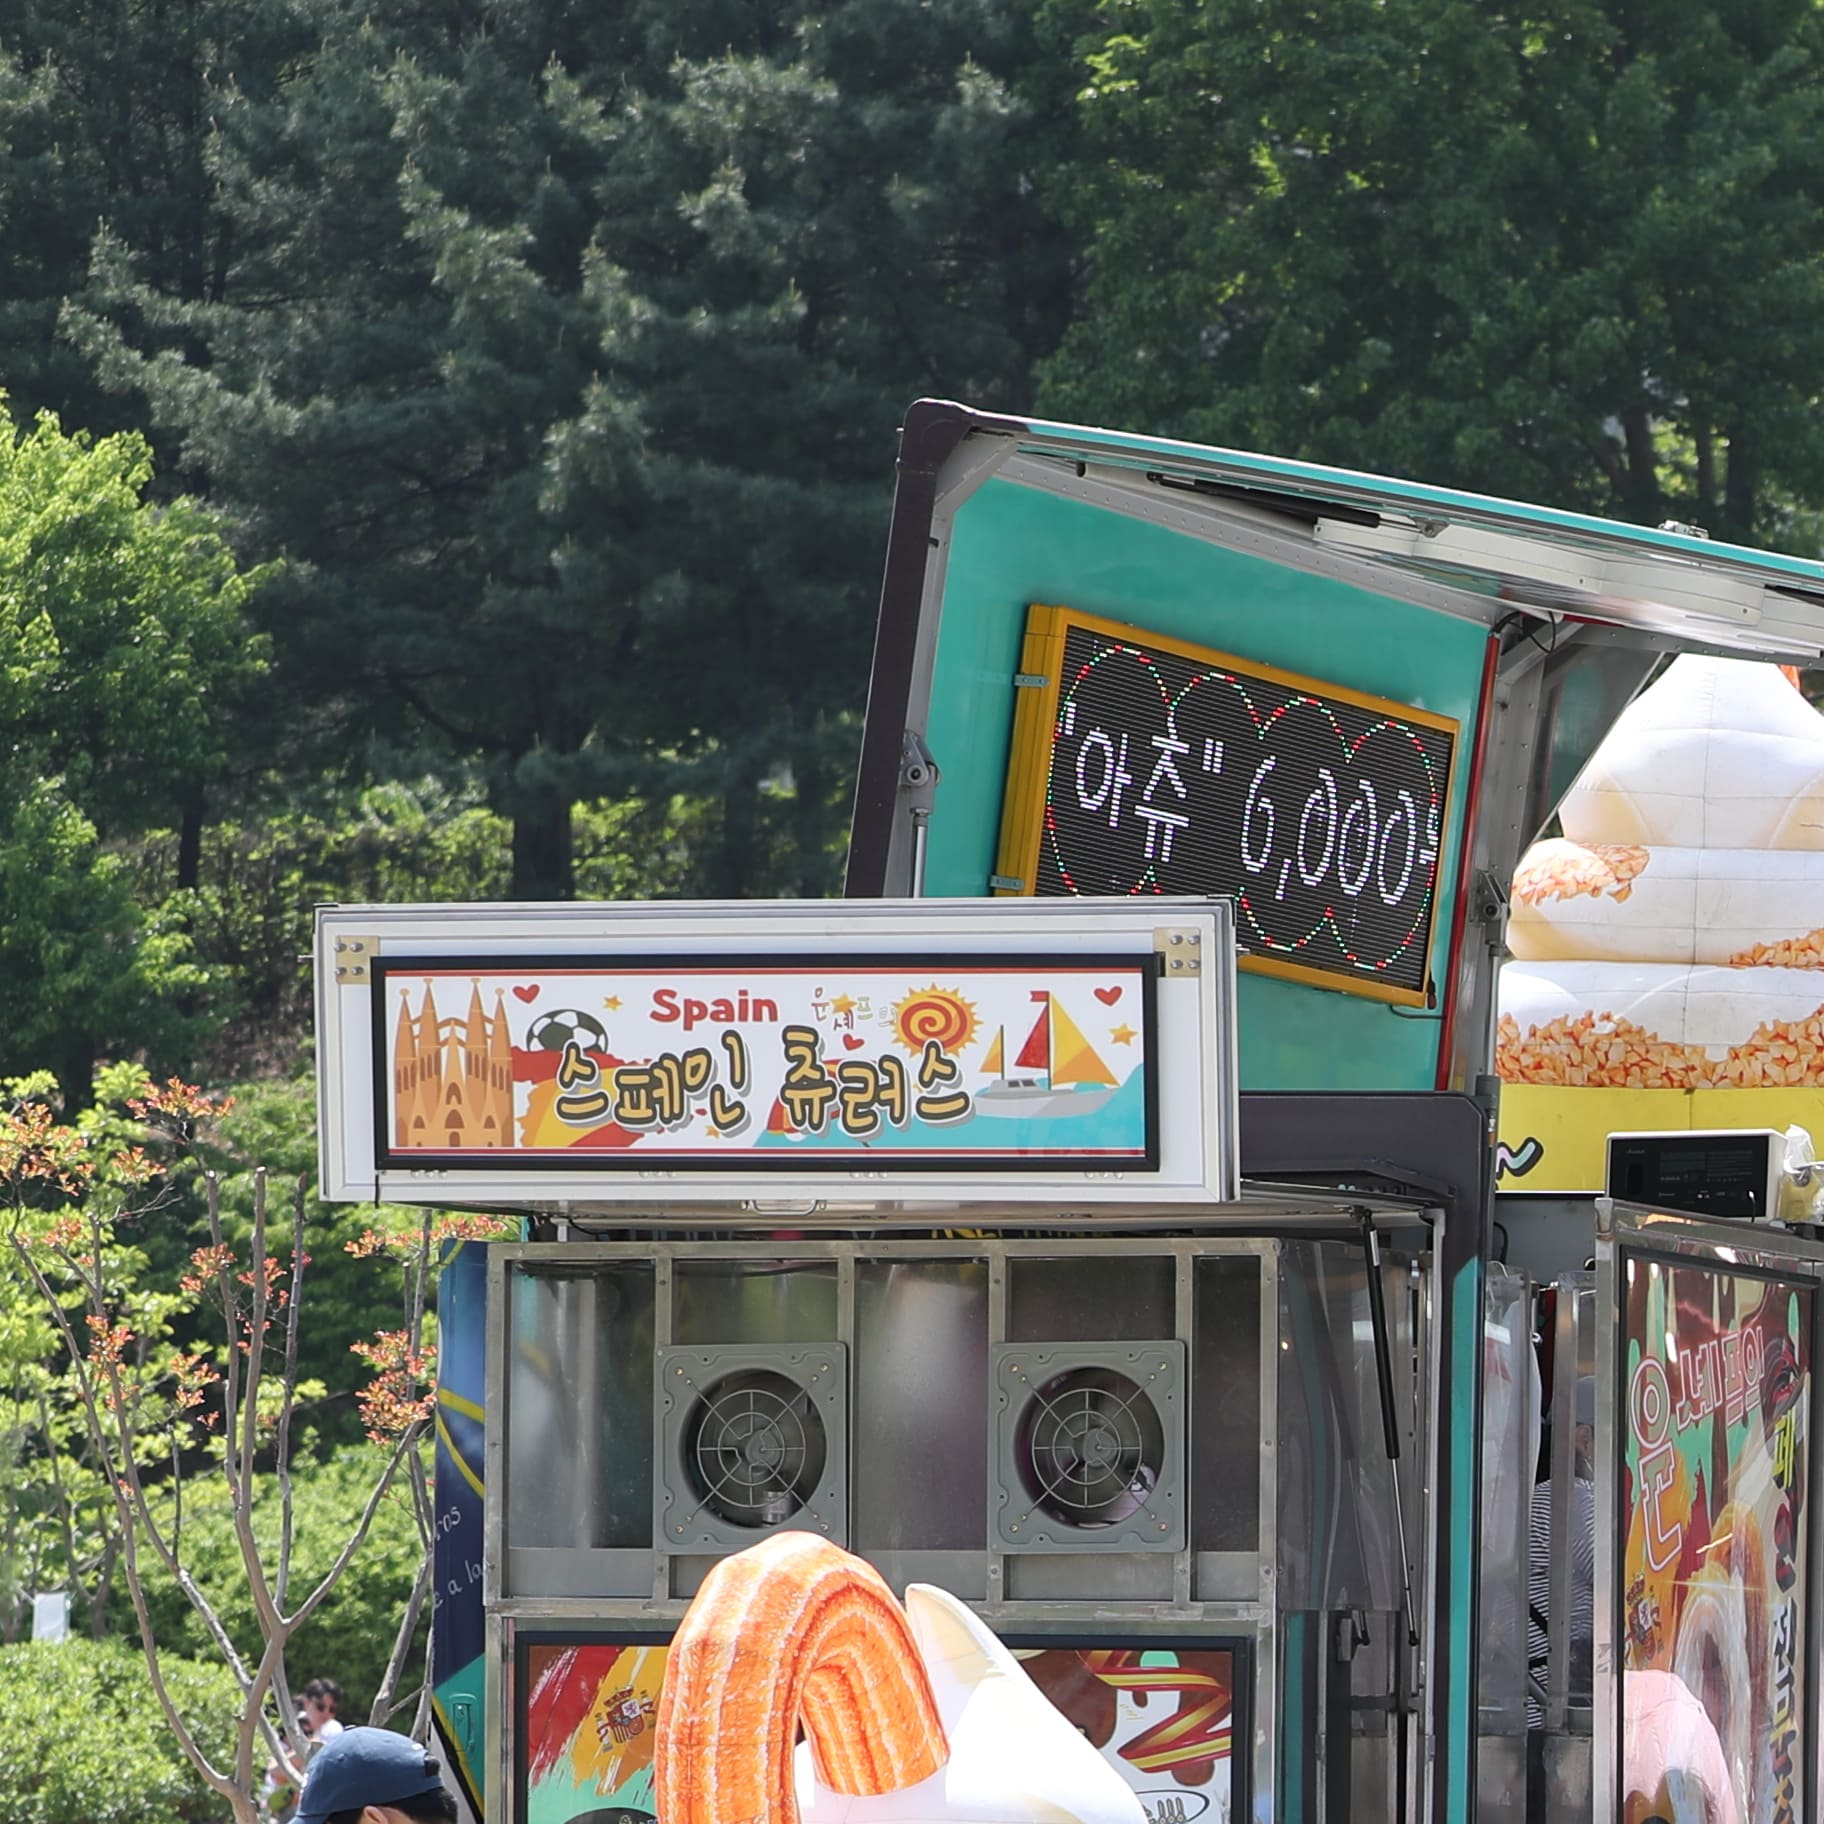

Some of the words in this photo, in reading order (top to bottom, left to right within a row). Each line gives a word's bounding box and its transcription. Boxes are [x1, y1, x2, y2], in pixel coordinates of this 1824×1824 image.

[650, 988, 778, 1032] Spain
[556, 1028, 748, 1130] 스페인
[780, 1025, 972, 1135] 츄러스
